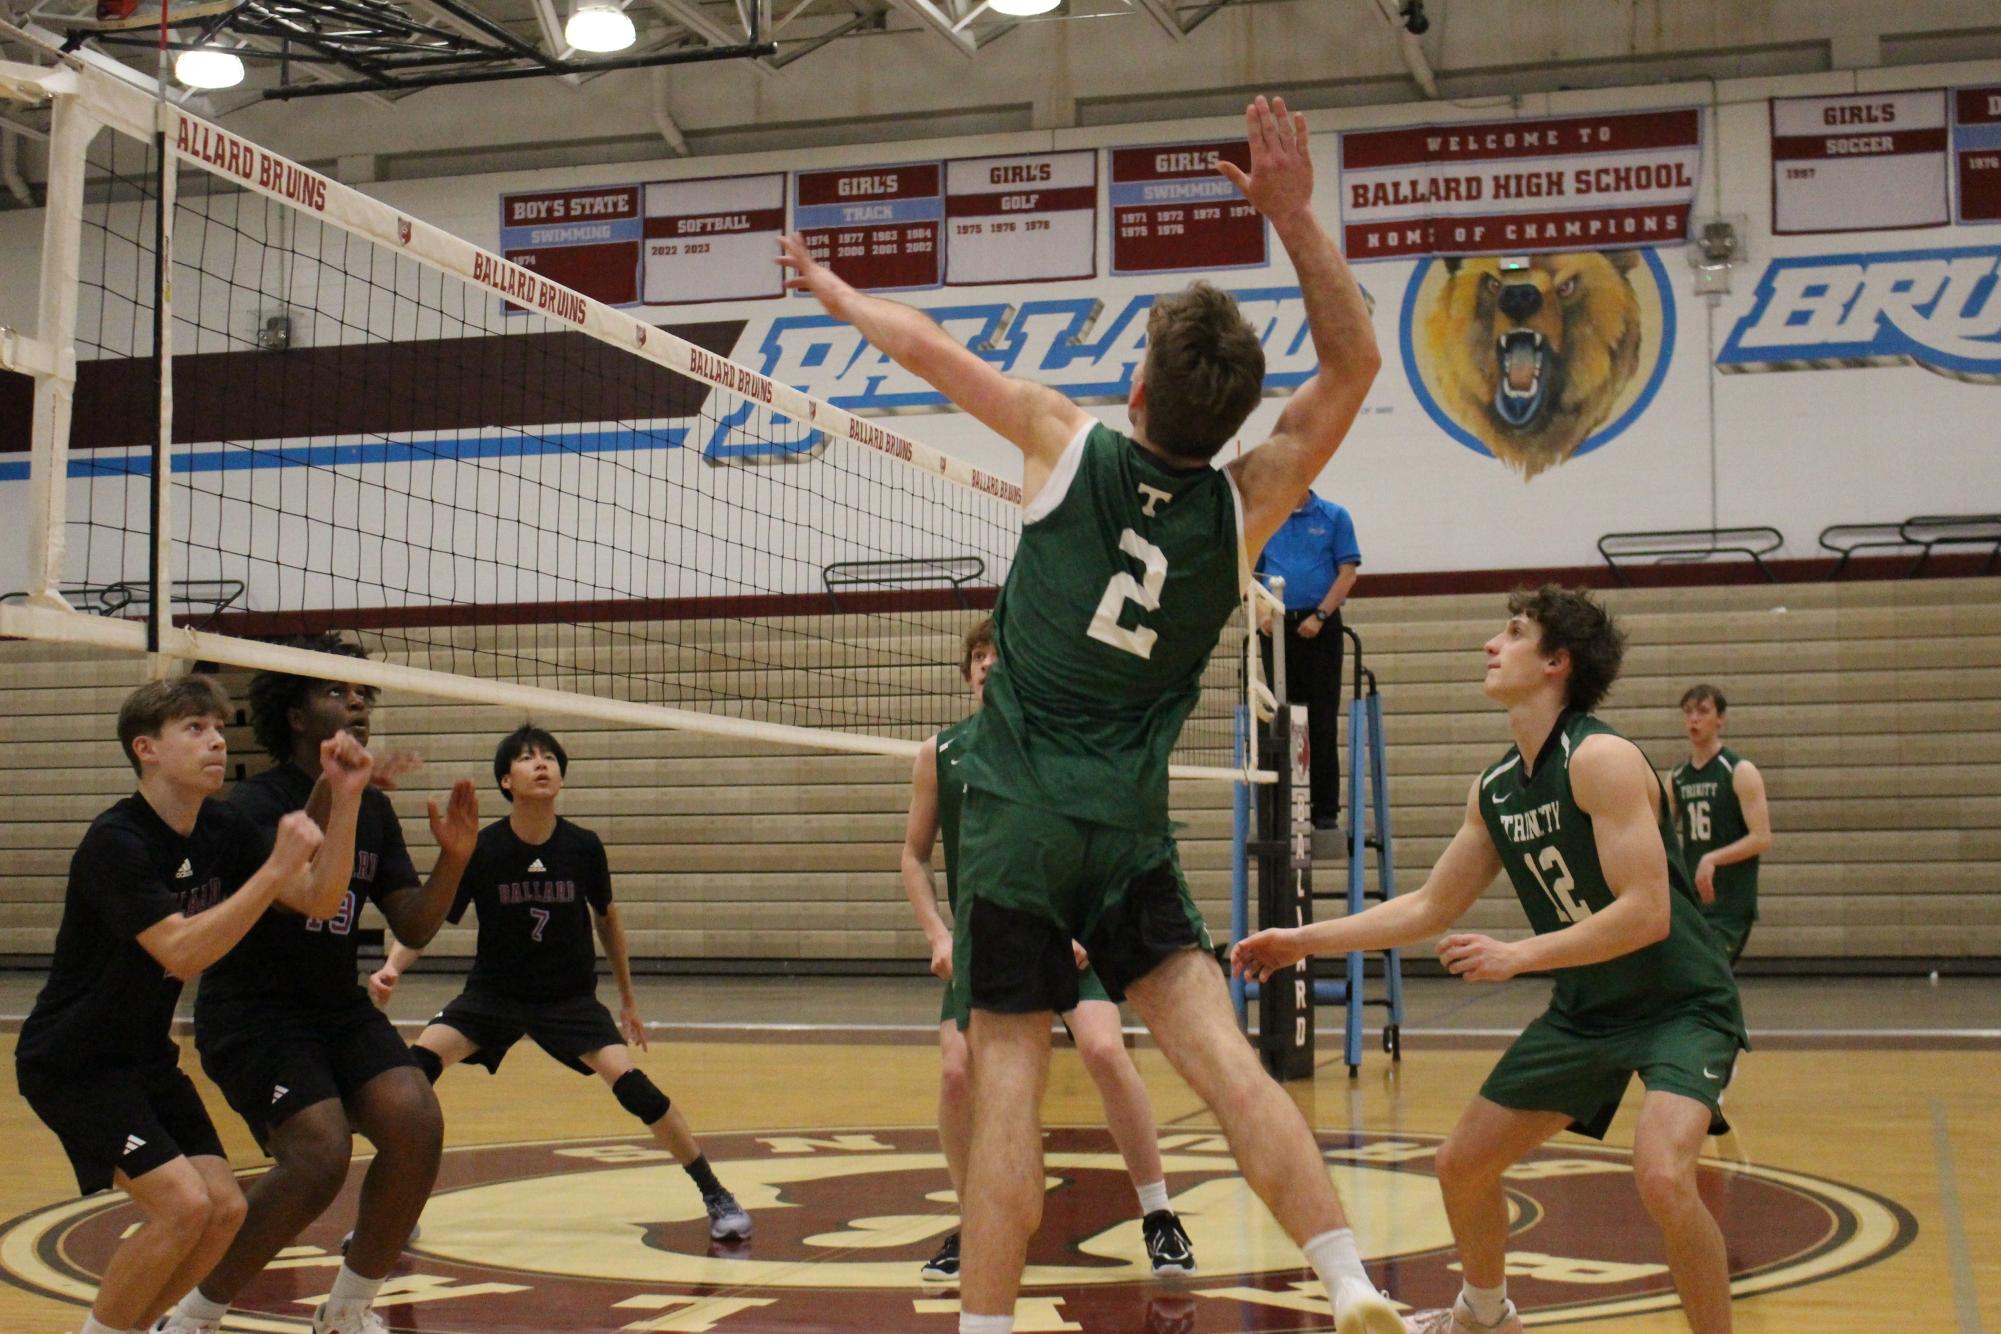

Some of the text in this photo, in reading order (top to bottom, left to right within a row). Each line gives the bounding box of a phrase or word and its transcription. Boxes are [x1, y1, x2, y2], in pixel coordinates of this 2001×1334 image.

[1823, 103, 1896, 126] GIRL'S
[1427, 126, 1611, 151] WELCOME TO
[1826, 136, 1894, 154] SOCCER
[177, 117, 327, 212] ALLARD BRUINS
[990, 163, 1052, 184] GIRL'S
[1155, 151, 1220, 172] GIRL'S
[838, 175, 898, 196] GIRL'S
[1143, 177, 1233, 200] SWIMMING
[1351, 162, 1693, 209] BALLARD HIGH SCHOOL
[513, 194, 630, 220] BOY'S STATE
[843, 206, 893, 221] TRACK
[1001, 194, 1039, 211] GOLF
[531, 224, 611, 244] SWIMMING
[677, 216, 750, 234] SOFTBALL
[1368, 214, 1678, 248] HOM OF CHAMPIONS
[651, 243, 710, 256] 2022 2023
[473, 251, 587, 325] BALLARD BRUINS
[689, 348, 773, 404] BALLARD BRUINS
[849, 417, 912, 462] BALLARD BRUINS
[971, 468, 1022, 505] BALLARD BRUINS
[1137, 482, 1173, 518] T
[1086, 527, 1168, 660] 2
[1681, 782, 1718, 800] TRINITY
[1500, 800, 1560, 842] TRINTY
[1687, 800, 1711, 840] 16
[499, 880, 576, 905] BALLARD
[1524, 845, 1593, 922] 12
[529, 908, 549, 942] 7
